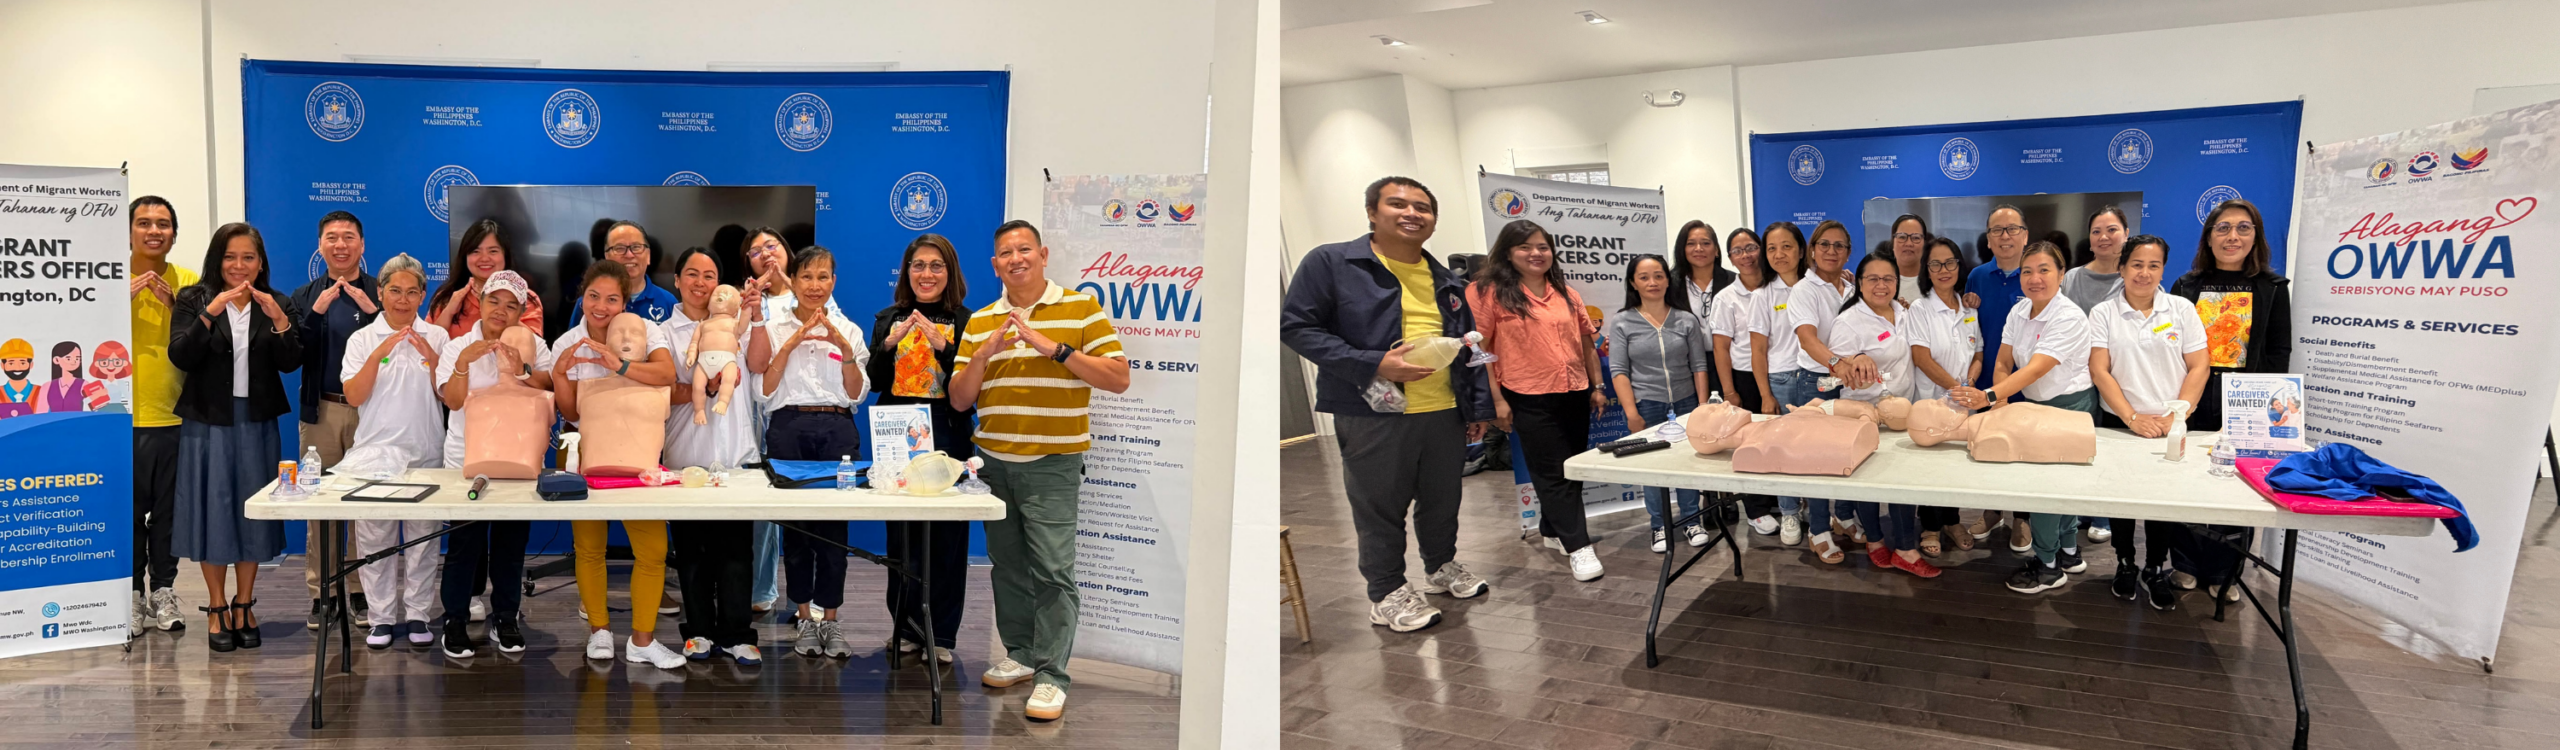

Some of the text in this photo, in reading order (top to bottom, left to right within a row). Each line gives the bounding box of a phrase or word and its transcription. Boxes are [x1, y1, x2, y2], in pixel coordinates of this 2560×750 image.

[22, 184, 34, 192] of
[36, 185, 77, 196] Migrant
[79, 187, 121, 196] Workers
[1532, 193, 1584, 204] Department
[1597, 199, 1628, 208] Migrant
[1629, 202, 1660, 210] Workers
[60, 205, 77, 223] ng
[81, 202, 118, 217] OFW
[1537, 206, 1564, 222] Ang
[1565, 207, 1614, 221] Tahanan
[1631, 212, 1659, 224] OFW
[2338, 212, 2497, 247] Alagang
[0, 238, 71, 256] RANT
[1555, 234, 1626, 250] IGRANT
[1556, 251, 1600, 264] KERS
[2327, 235, 2516, 279] OWWA
[42, 261, 123, 279] OFFICE
[1081, 251, 1204, 290] Alagang
[1563, 270, 1622, 283] hington,
[0, 287, 96, 306] ngton, DC
[2330, 286, 2508, 297] SERBISYONG MAY PUSO
[1155, 328, 1181, 337] MAY
[2312, 316, 2519, 336] PROGRAMS & SERVICES
[2299, 337, 2376, 350] Social Benefits
[1144, 361, 1153, 370] &
[2372, 356, 2400, 364] Benefit
[2409, 368, 2438, 377] Benefit
[2359, 371, 2388, 380] Medical
[2389, 375, 2432, 385] Assistance
[2448, 382, 2474, 390] OFWs
[2228, 391, 2269, 399] CAREGIVERS
[2304, 385, 2416, 408] ucation and Training
[2228, 399, 2266, 408] WANTED!
[874, 420, 907, 429] CAREGIVERS
[875, 428, 905, 436] WANTED!
[2325, 428, 2383, 446] Assistance
[1119, 436, 1160, 447] Training
[20, 473, 104, 490] OFFERED:
[1083, 477, 1137, 489] Assistance
[12, 495, 80, 507] Assistance
[13, 508, 84, 522] Verification
[8, 537, 92, 553] Accreditation
[1103, 532, 1156, 545] Assistance
[0, 549, 116, 568] bership Enrollment
[1106, 584, 1149, 598] Program
